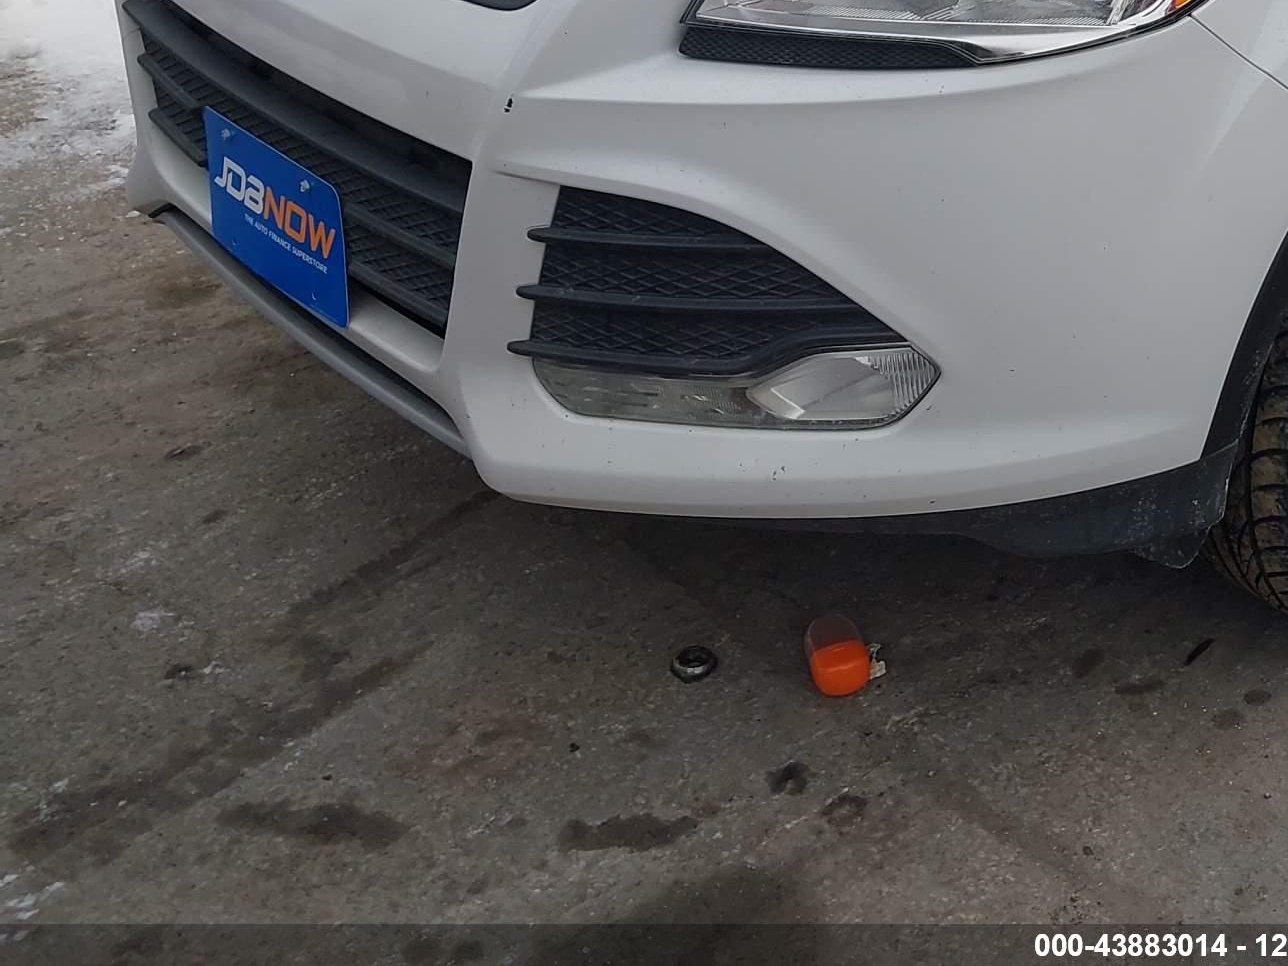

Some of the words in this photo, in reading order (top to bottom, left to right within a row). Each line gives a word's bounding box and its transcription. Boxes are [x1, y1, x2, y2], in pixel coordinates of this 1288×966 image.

[254, 221, 269, 236] AUTO
[268, 230, 292, 251] FINANCE
[292, 246, 328, 274] SUPERSTORE
